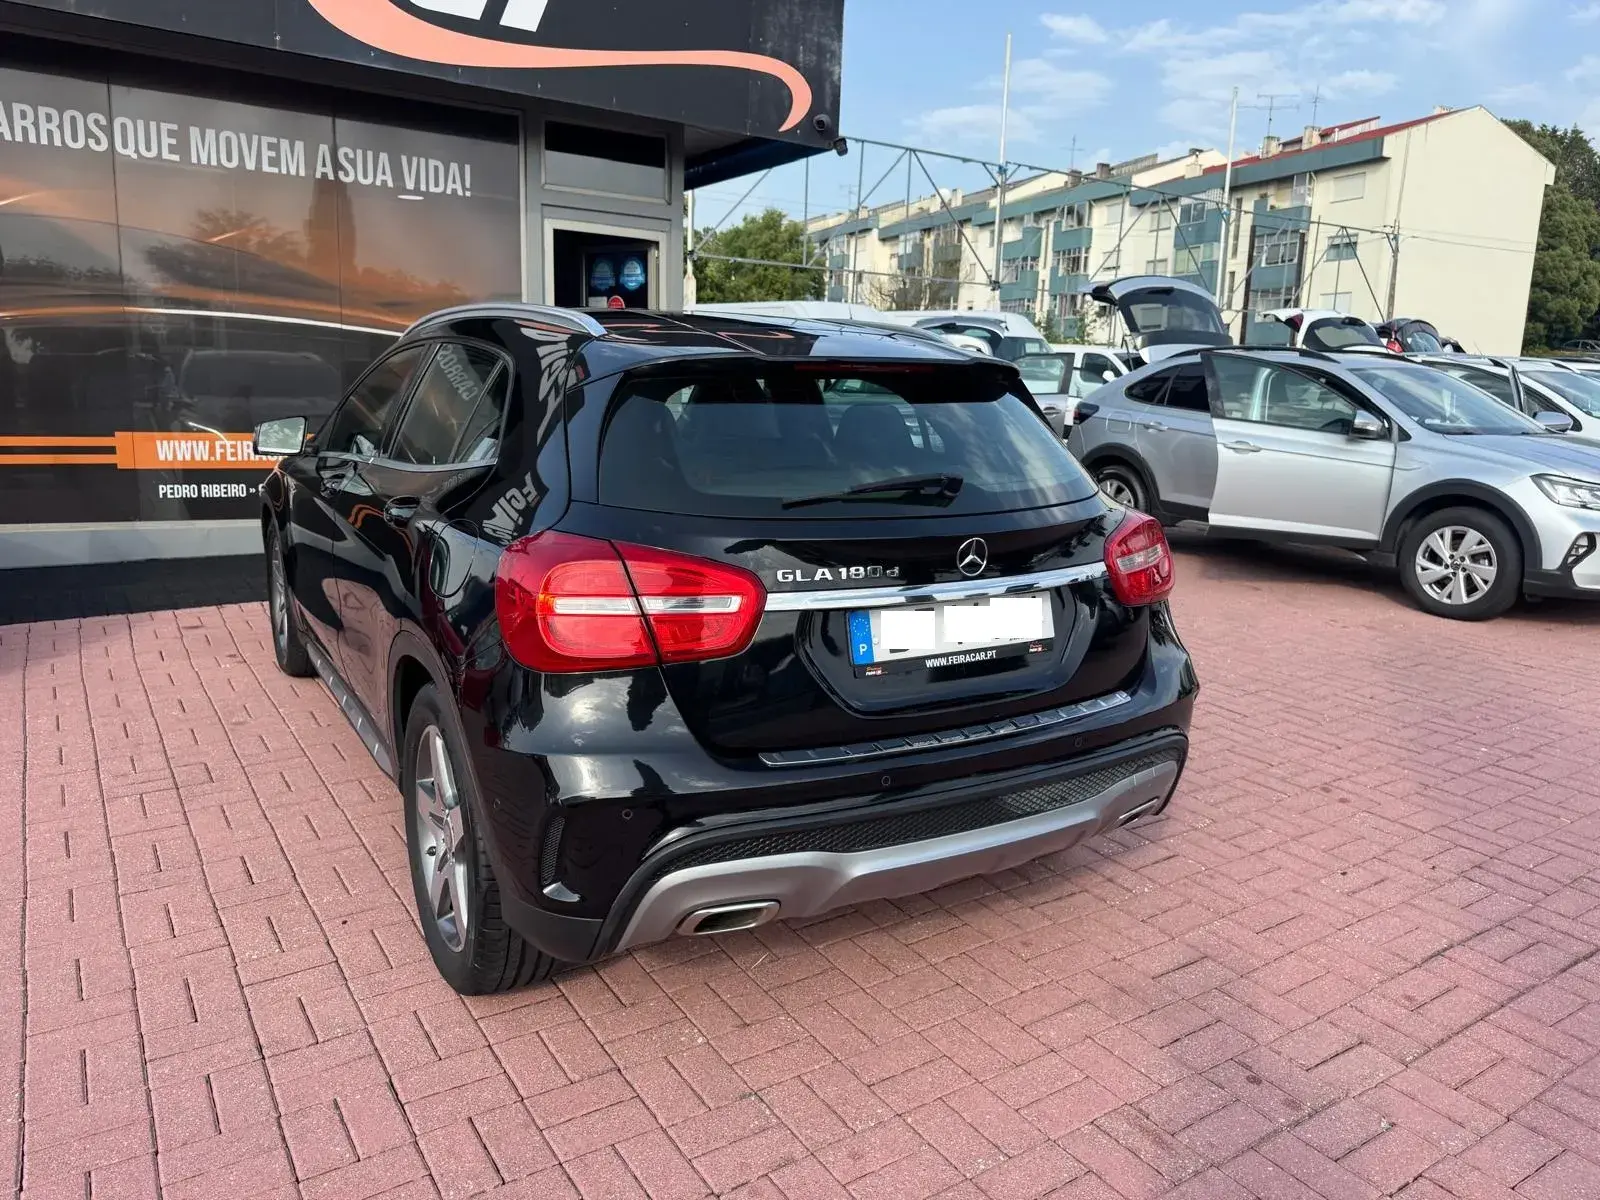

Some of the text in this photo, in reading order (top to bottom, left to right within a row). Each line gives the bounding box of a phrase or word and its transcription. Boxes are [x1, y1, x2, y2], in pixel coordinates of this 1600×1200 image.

[113, 116, 180, 162] QUE
[189, 125, 306, 177] MOVEM
[337, 146, 394, 188] SUA
[401, 154, 472, 197] VIDA!
[158, 484, 198, 498] PEDRO
[201, 483, 247, 498] RIBEIRO
[859, 643, 868, 656] P
[925, 650, 997, 668] WWW.FEIRACAR.PT
